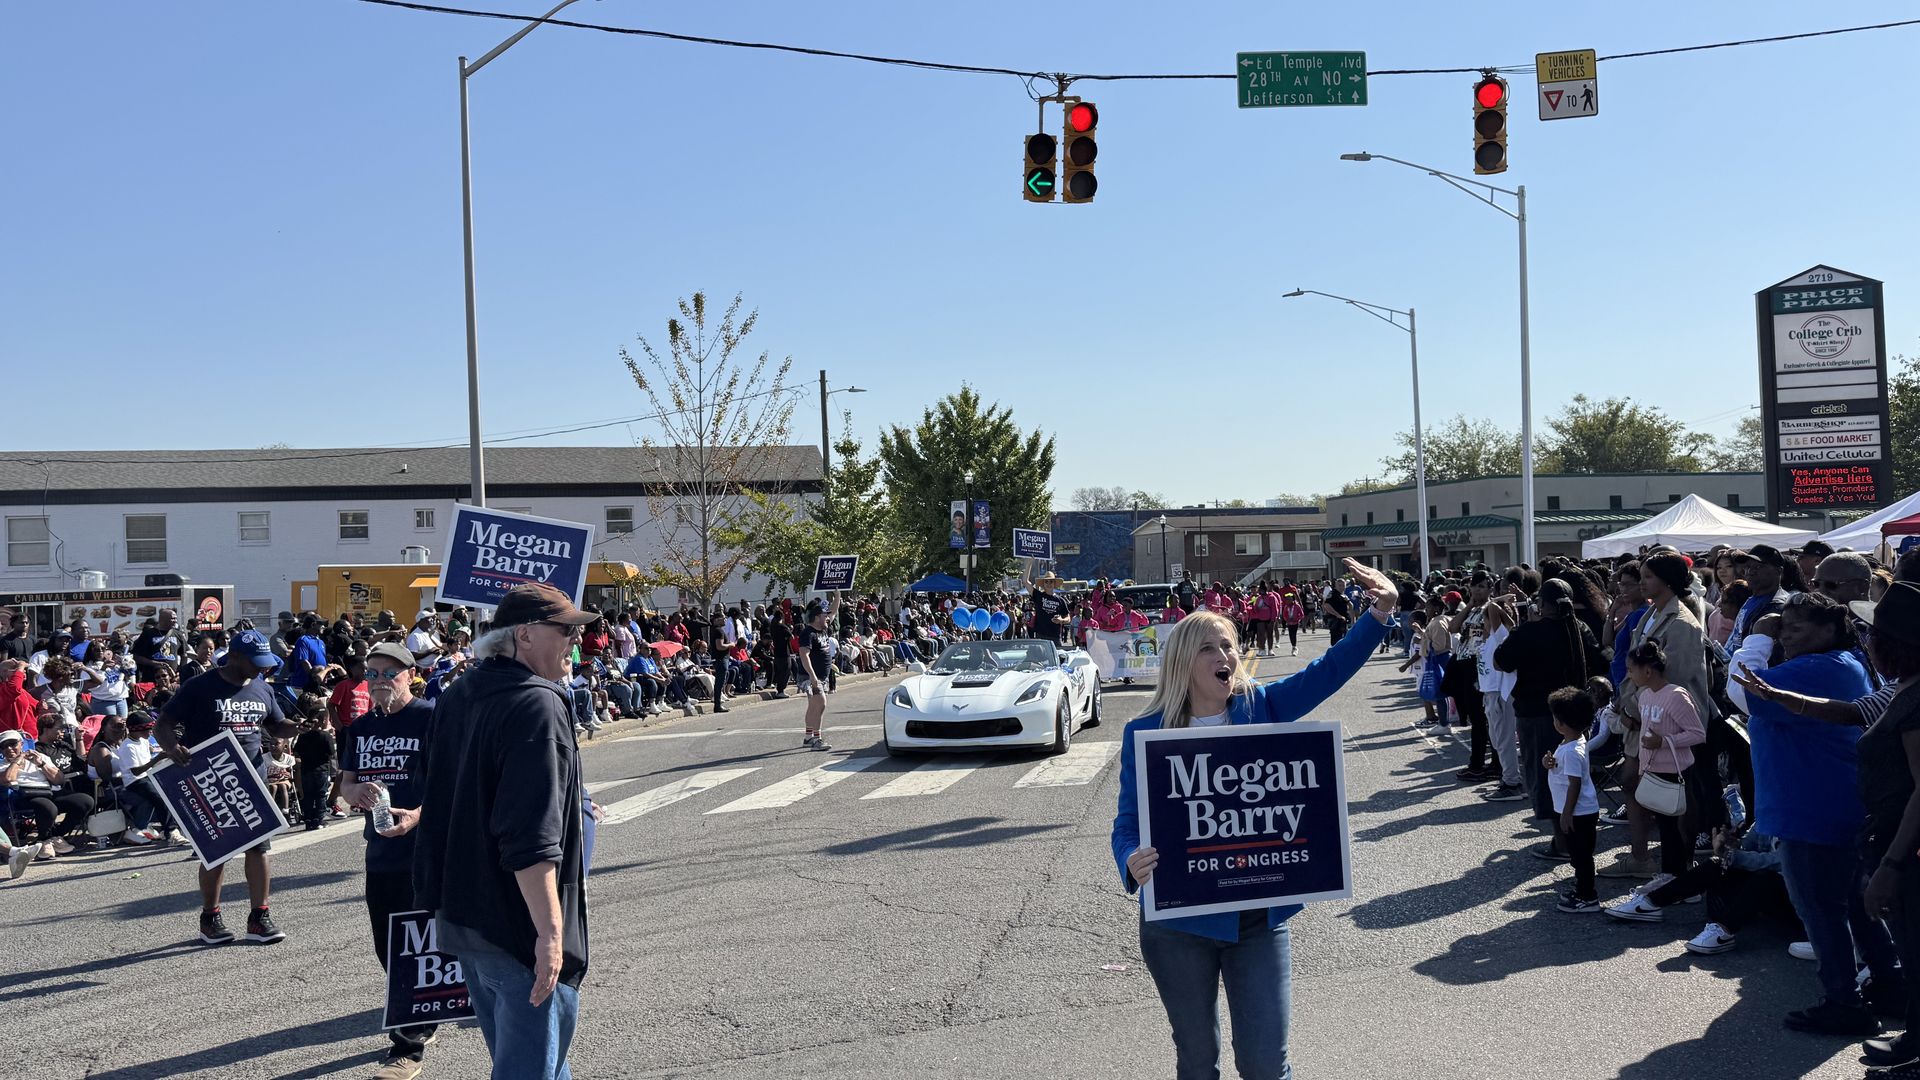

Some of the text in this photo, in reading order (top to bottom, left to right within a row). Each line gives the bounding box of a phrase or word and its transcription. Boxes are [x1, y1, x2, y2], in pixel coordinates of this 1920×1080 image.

[1281, 54, 1322, 71] Temple
[1341, 56, 1361, 68] lvd
[1548, 54, 1584, 67] TURNING
[1294, 76, 1308, 86] AV
[1322, 71, 1341, 86] NO
[1549, 66, 1585, 80] VEHICLES
[1244, 88, 1342, 105] Jefferson St
[1567, 95, 1577, 107] TO
[1808, 273, 1833, 282] 2719
[1783, 288, 1863, 300] PRICE
[1783, 297, 1864, 309] PLAZA
[1788, 326, 1862, 340] College Crib
[1811, 404, 1848, 415] cricket
[1810, 436, 1834, 444] FOOD
[1836, 434, 1872, 442] MARKET
[1784, 450, 1877, 461] United Cellular
[1794, 474, 1873, 485] Advertise Here
[466, 519, 571, 559] Megan
[1018, 532, 1046, 543] Megan
[1021, 540, 1043, 549] Barry
[472, 546, 558, 583] Barry
[822, 561, 852, 571] Megan
[823, 570, 847, 579] Barry
[469, 576, 491, 587] FOR
[14, 592, 66, 603] CARNIVAL
[92, 591, 138, 600] WHEELS!
[215, 698, 266, 713] Megan
[220, 711, 262, 724] Barry
[356, 735, 420, 754] Megan
[358, 753, 410, 770] Barry
[1165, 753, 1320, 803] Megan
[207, 749, 263, 830] Megan
[193, 767, 239, 830] Barry
[177, 780, 190, 797] FOR
[189, 799, 218, 840] CONGRESS
[1184, 799, 1305, 842] Barry
[1188, 849, 1310, 873] FOR CONGRESS
[412, 1001, 440, 1014] FOR
